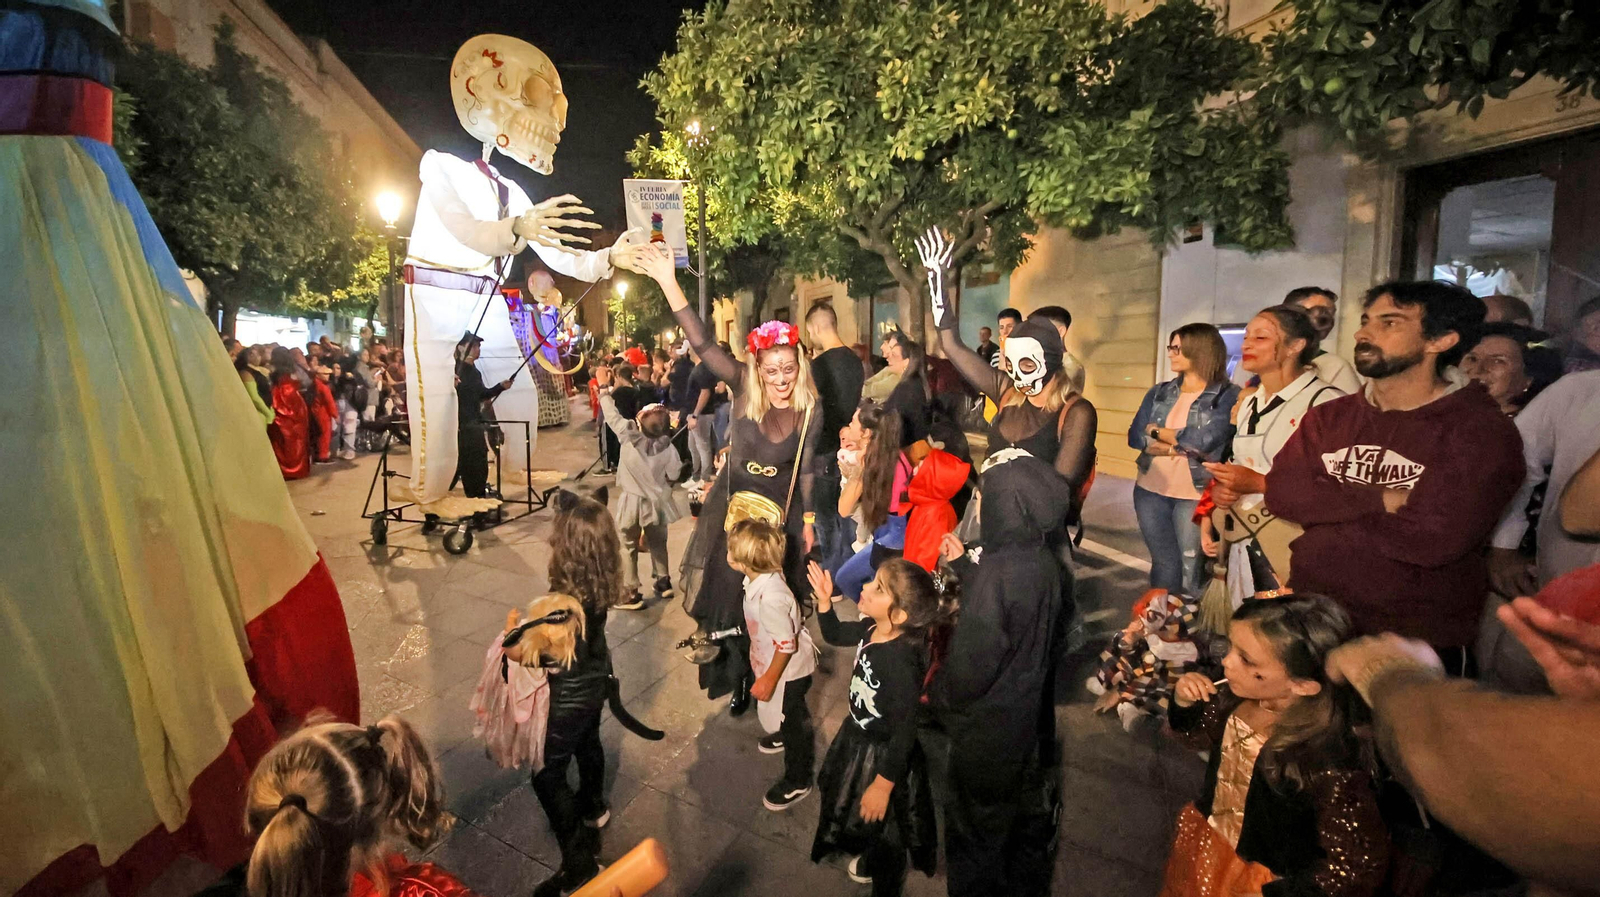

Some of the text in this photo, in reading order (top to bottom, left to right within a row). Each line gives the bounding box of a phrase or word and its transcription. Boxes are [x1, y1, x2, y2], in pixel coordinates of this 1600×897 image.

[640, 192, 680, 201] ECONOMÍA
[655, 202, 680, 210] SOCIAL
[1355, 462, 1376, 480] TH
